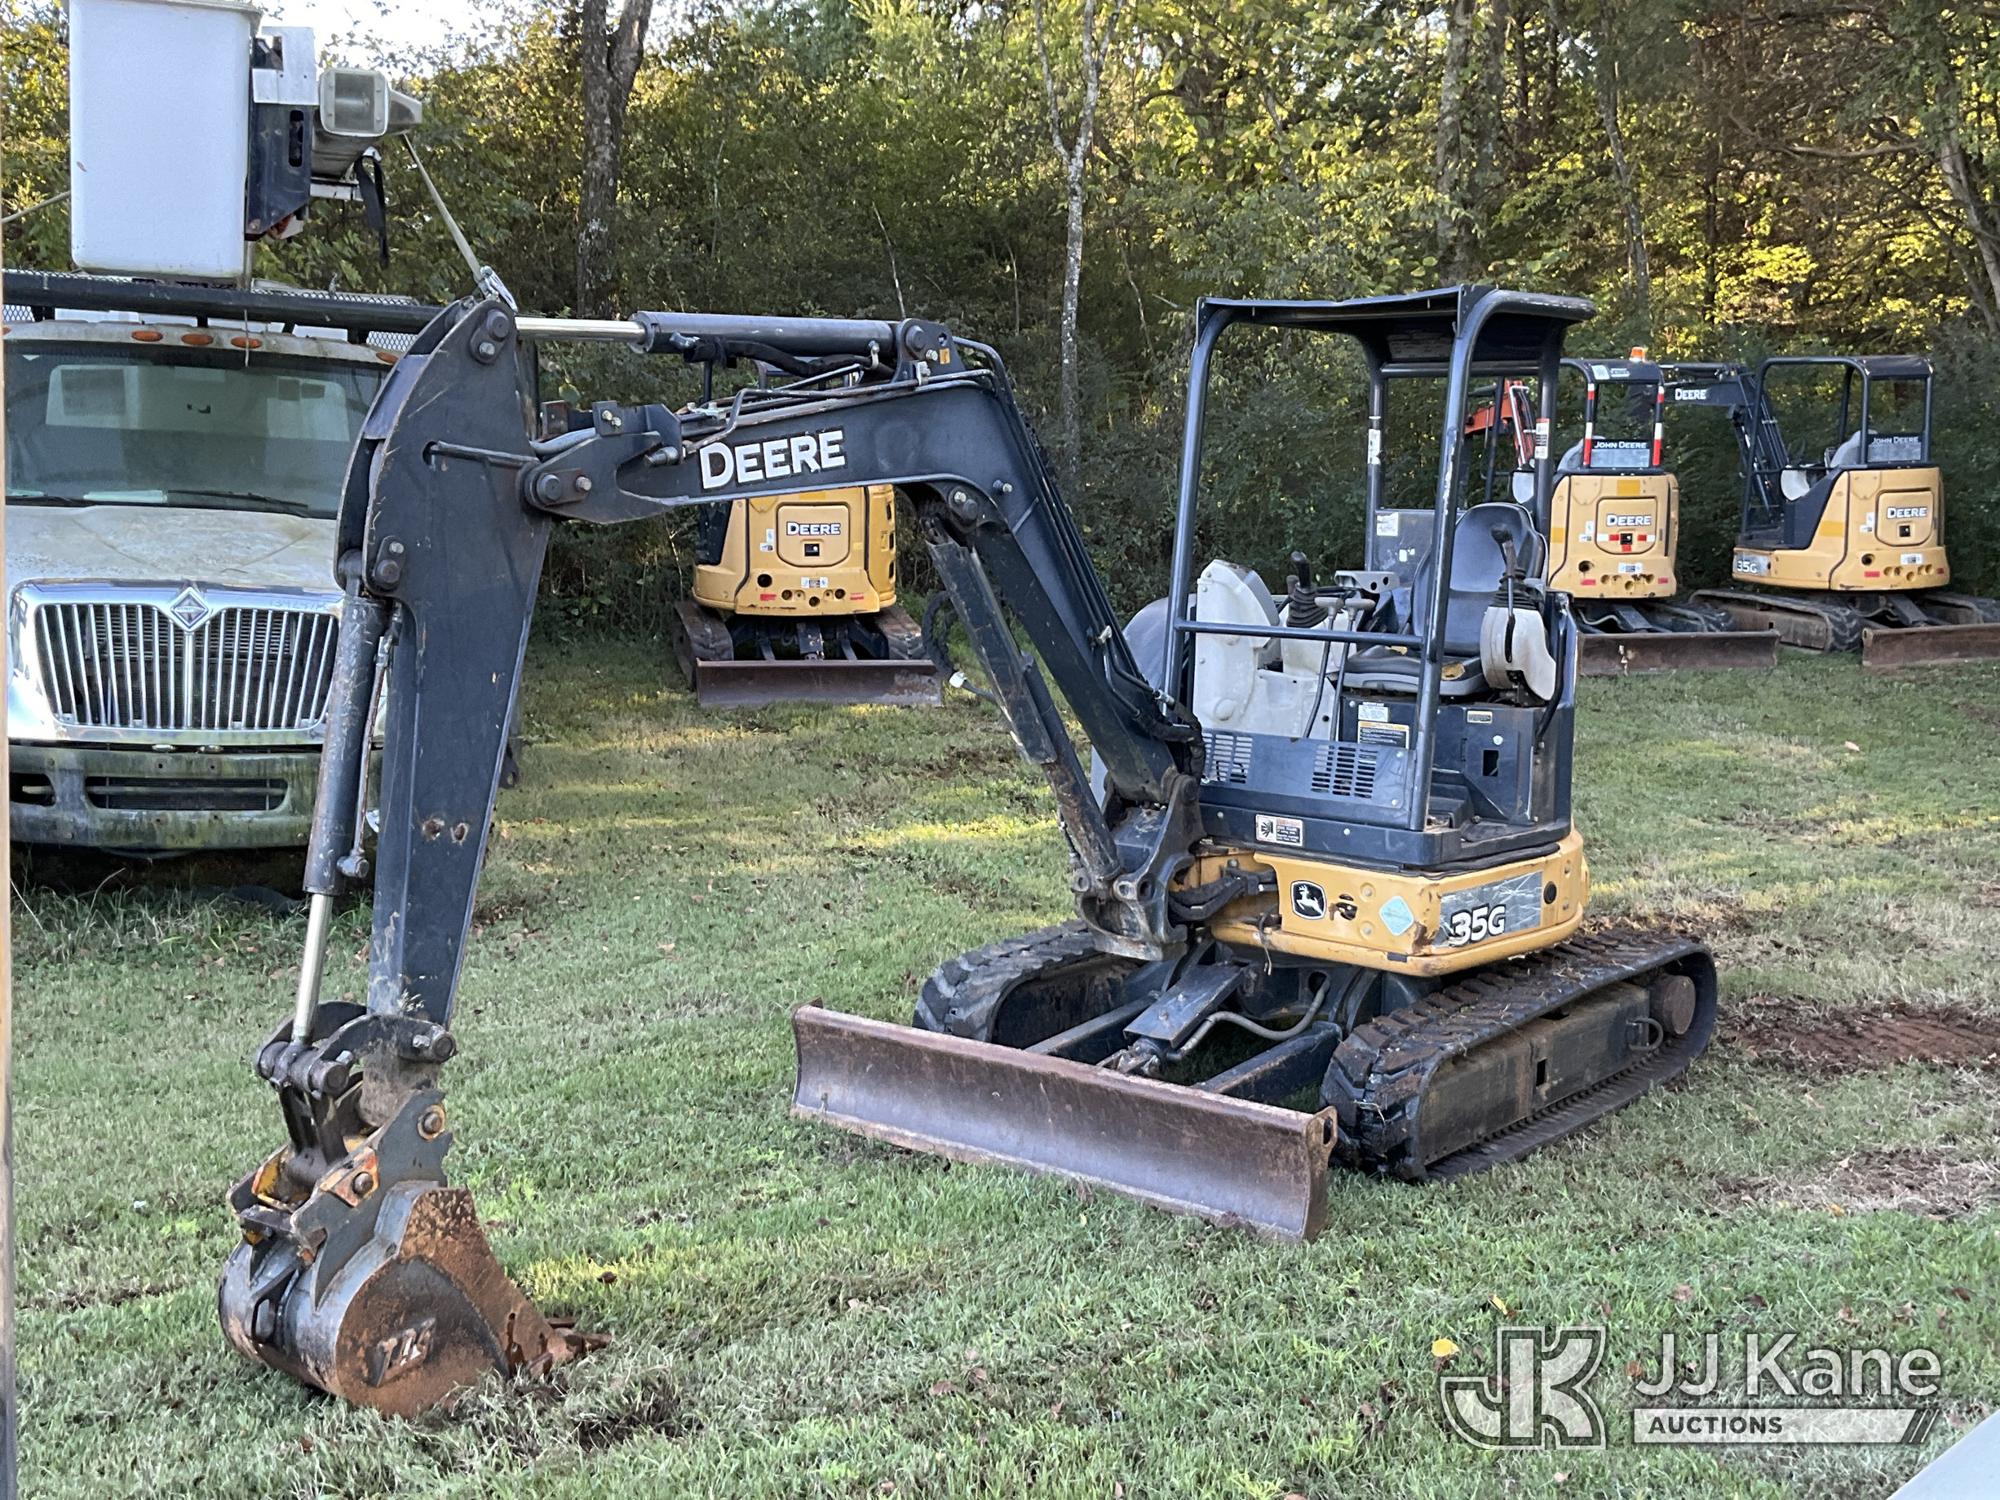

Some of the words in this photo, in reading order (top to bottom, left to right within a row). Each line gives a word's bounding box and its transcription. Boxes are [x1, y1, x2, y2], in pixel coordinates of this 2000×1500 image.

[1674, 387, 1707, 400] DEERE
[1618, 441, 1647, 449] DEERE
[1872, 437, 1893, 445] JOHN
[699, 429, 846, 490] DEERE
[1606, 513, 1652, 527] DEERE
[1886, 507, 1927, 519] DEERE
[786, 521, 841, 536] DEERE
[1736, 560, 1758, 574] 35G
[1449, 904, 1506, 947] 35G
